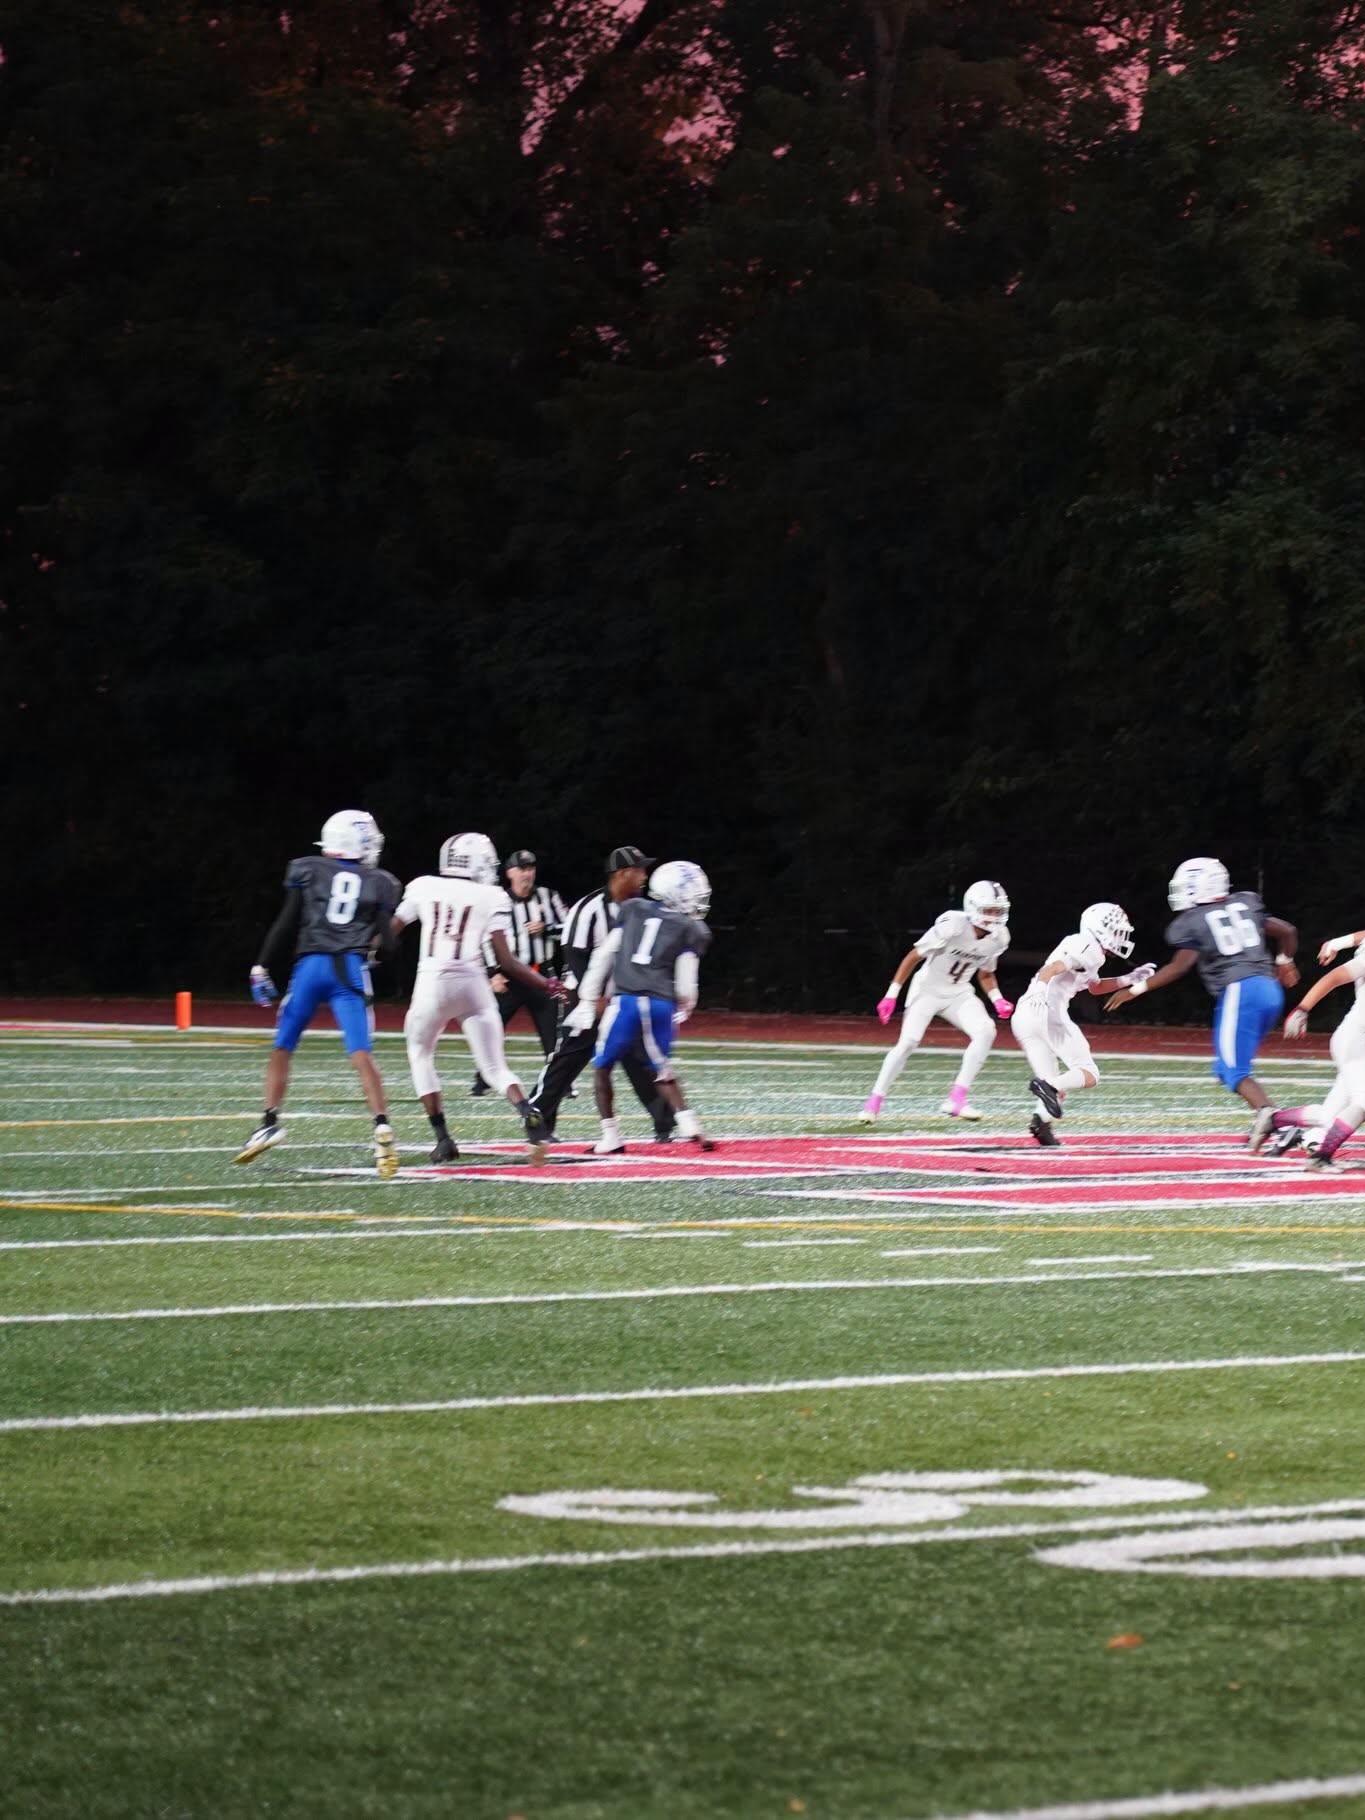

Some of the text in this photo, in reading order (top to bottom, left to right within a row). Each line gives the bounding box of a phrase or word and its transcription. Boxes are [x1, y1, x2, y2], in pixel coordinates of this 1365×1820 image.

[326, 871, 362, 924] 8
[427, 901, 473, 960] 14
[631, 917, 663, 964] 1
[1204, 902, 1261, 956] 66
[948, 960, 973, 985] 4
